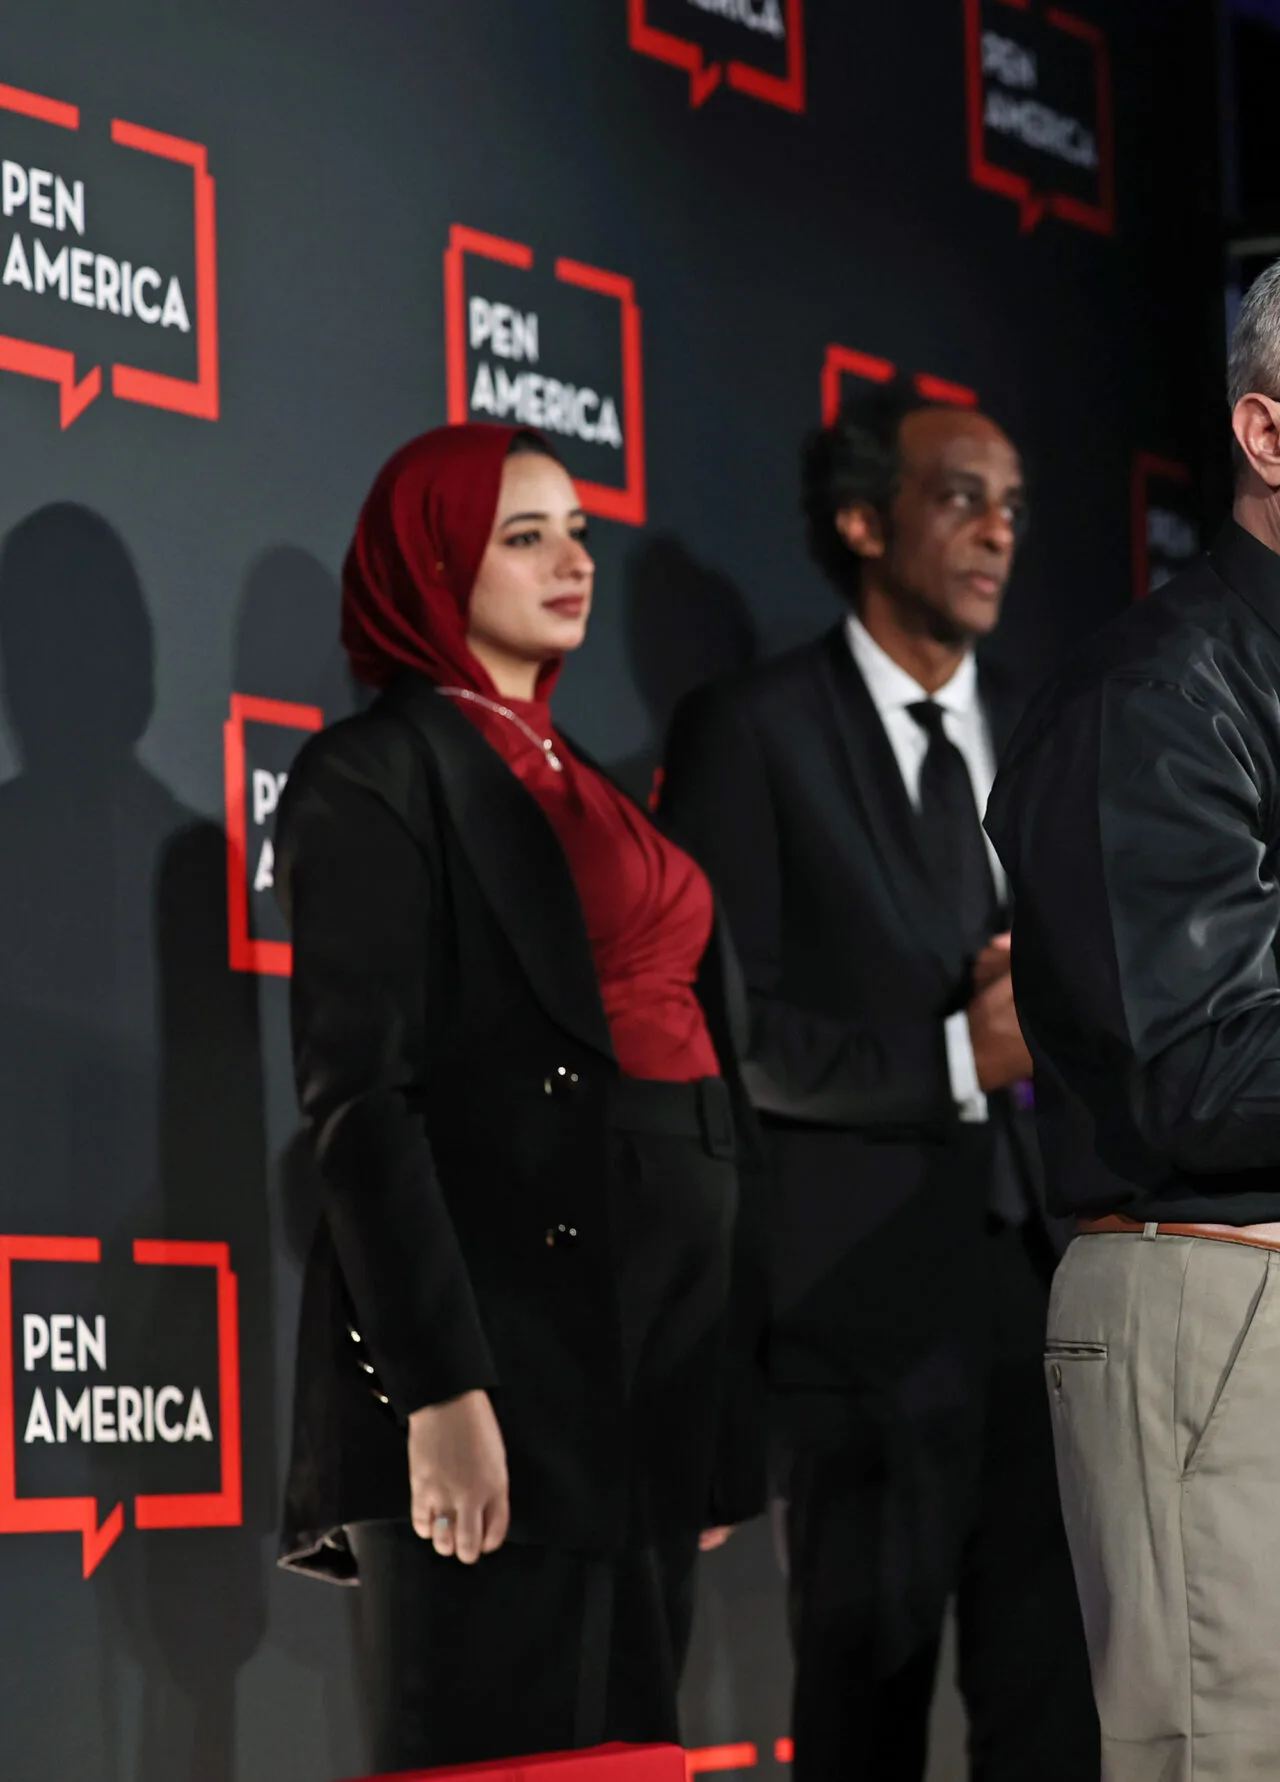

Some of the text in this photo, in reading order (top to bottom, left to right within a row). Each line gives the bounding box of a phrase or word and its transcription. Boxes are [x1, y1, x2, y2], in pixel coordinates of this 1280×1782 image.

[2, 160, 85, 236] PEN
[3, 232, 190, 332] AMERICA
[470, 296, 539, 365] PEN
[471, 362, 623, 449] AMERICA
[23, 1313, 107, 1372] PEN
[24, 1385, 214, 1444] AMERICA
